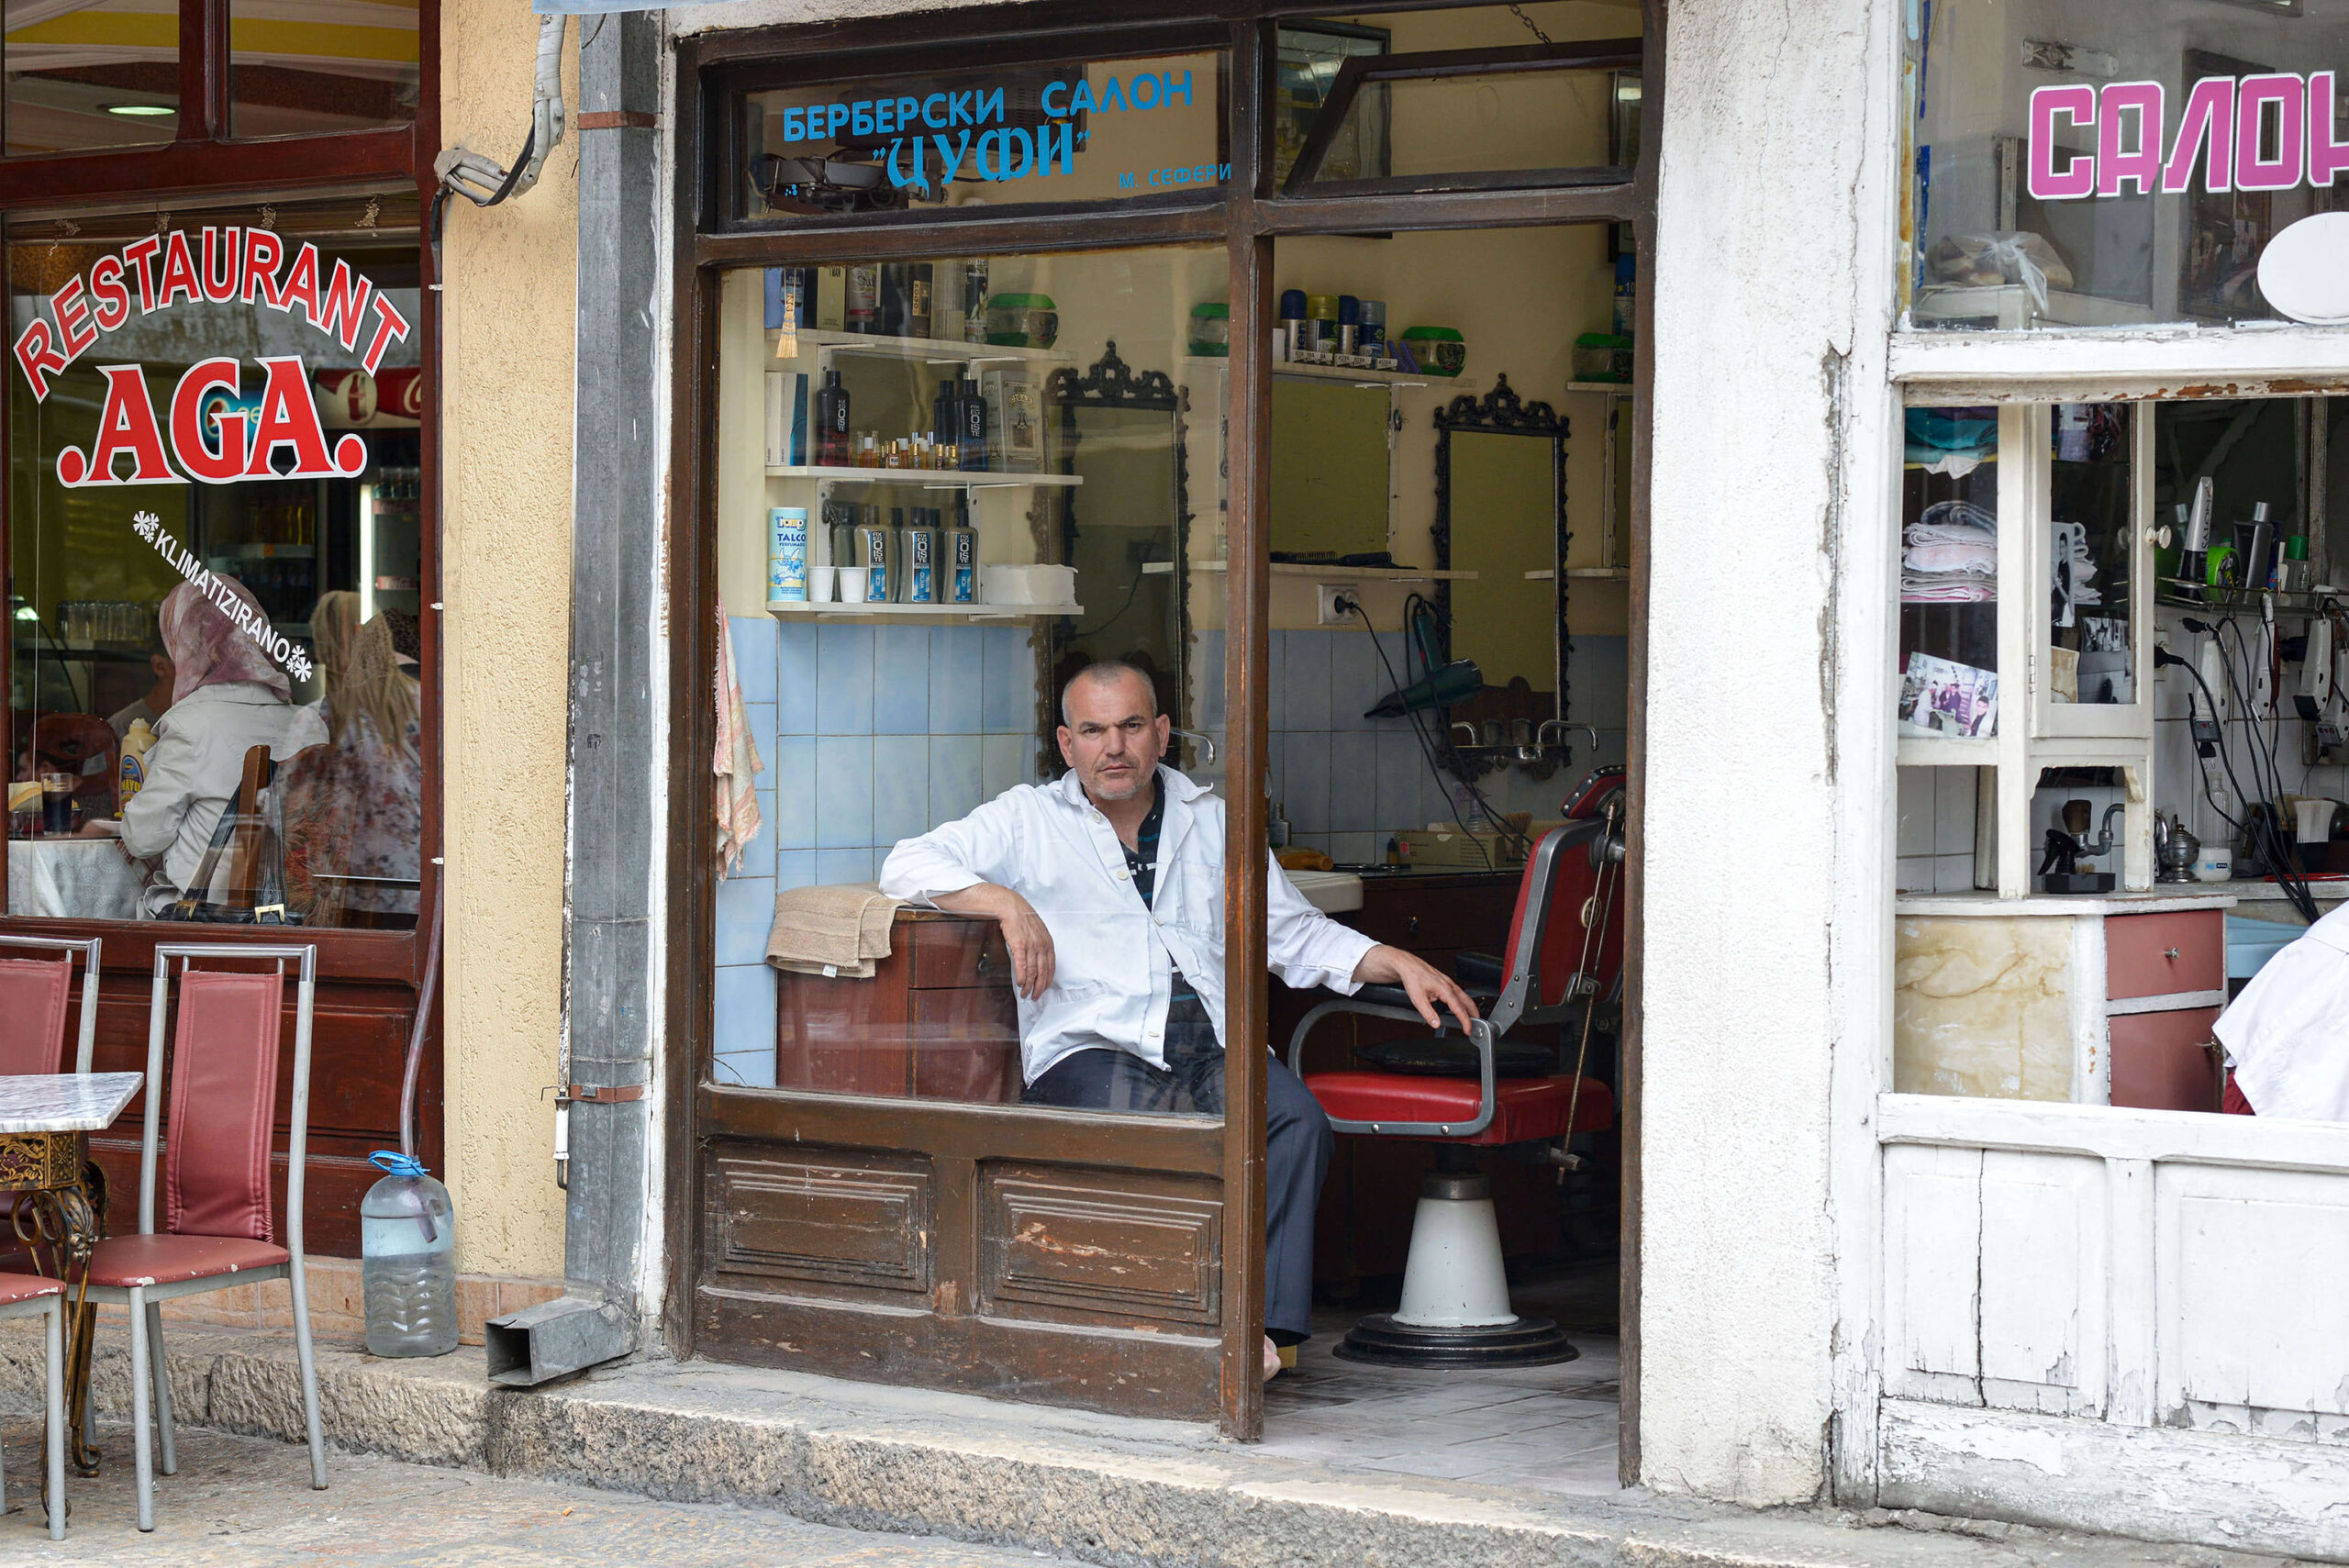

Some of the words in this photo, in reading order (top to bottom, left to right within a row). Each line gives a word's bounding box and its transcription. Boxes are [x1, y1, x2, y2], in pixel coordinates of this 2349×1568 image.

[783, 86, 1005, 142] БЕРБЕРСКИ
[1041, 70, 1193, 117] САЛОН
[13, 226, 411, 404] RESTAURANT
[777, 533, 807, 541] TALCO
[154, 528, 289, 663] KLIMATIZIRANO
